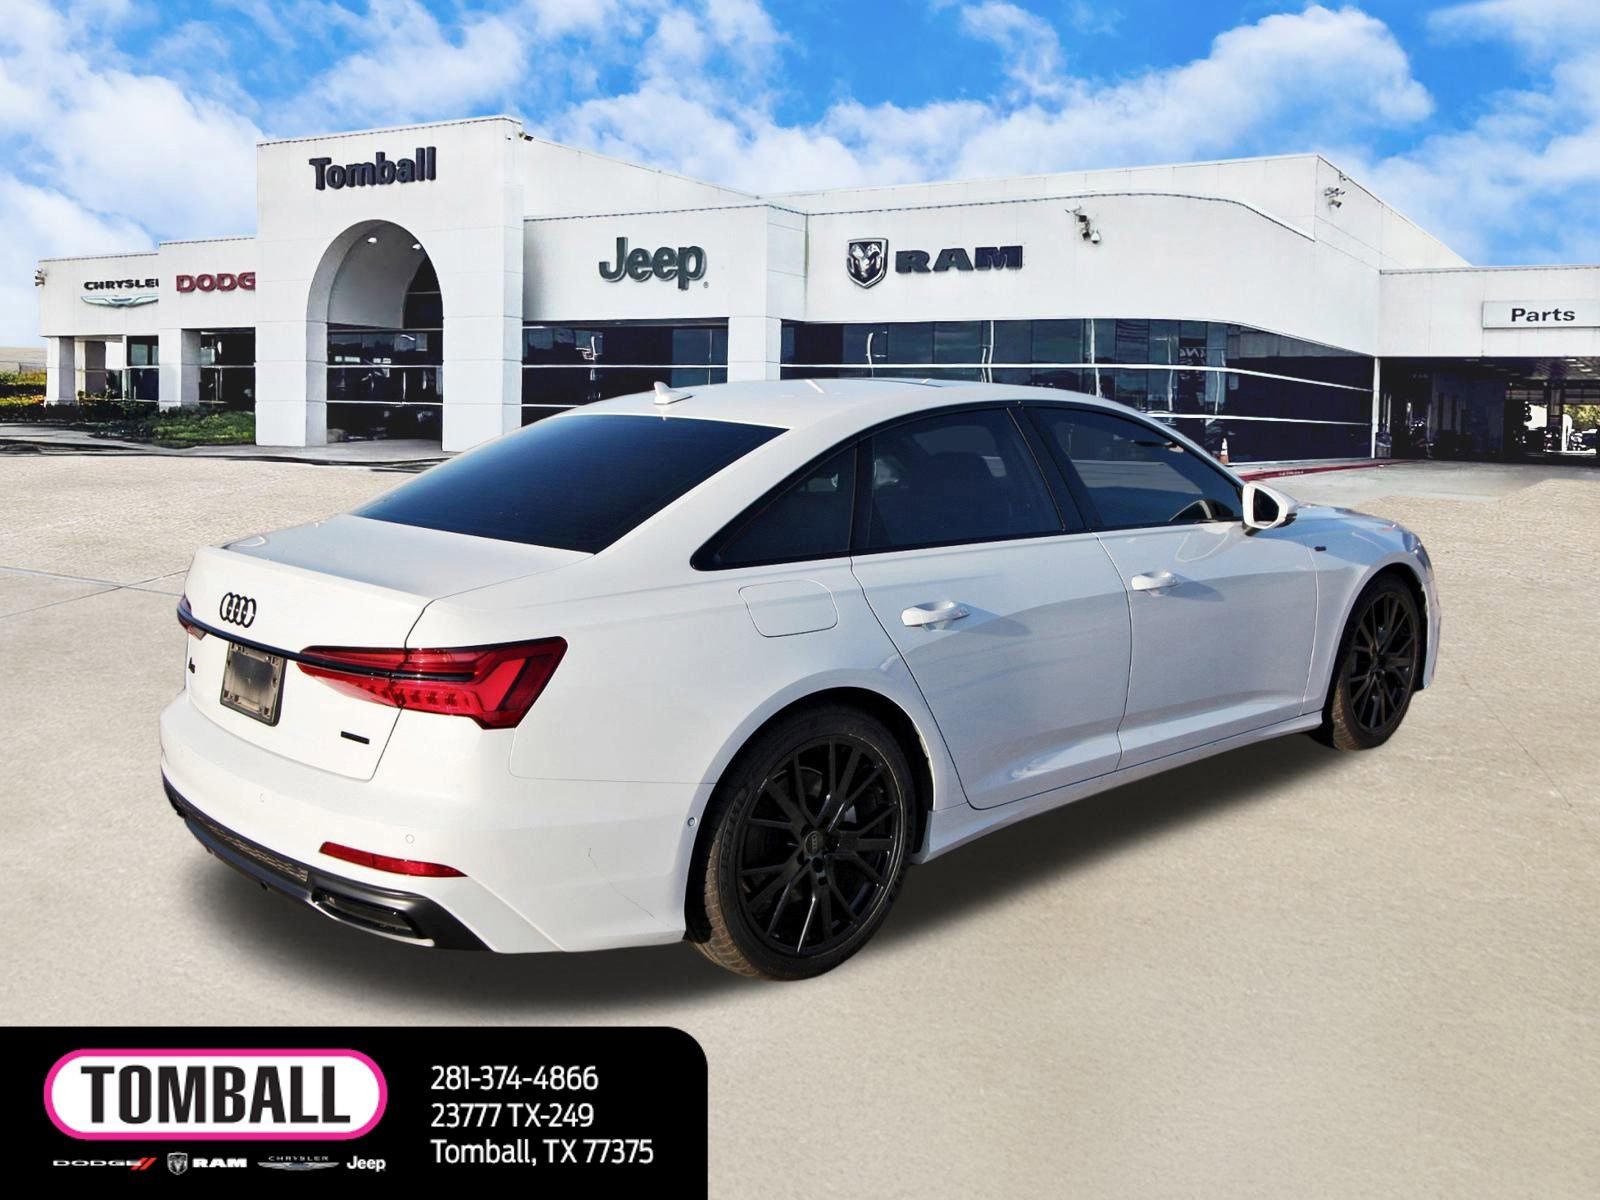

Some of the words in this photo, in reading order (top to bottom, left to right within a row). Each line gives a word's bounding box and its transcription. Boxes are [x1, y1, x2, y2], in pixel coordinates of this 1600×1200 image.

[308, 146, 437, 191] Tomball
[598, 236, 706, 290] Jeep
[895, 245, 1024, 274] RAM
[1511, 307, 1576, 323] Parts
